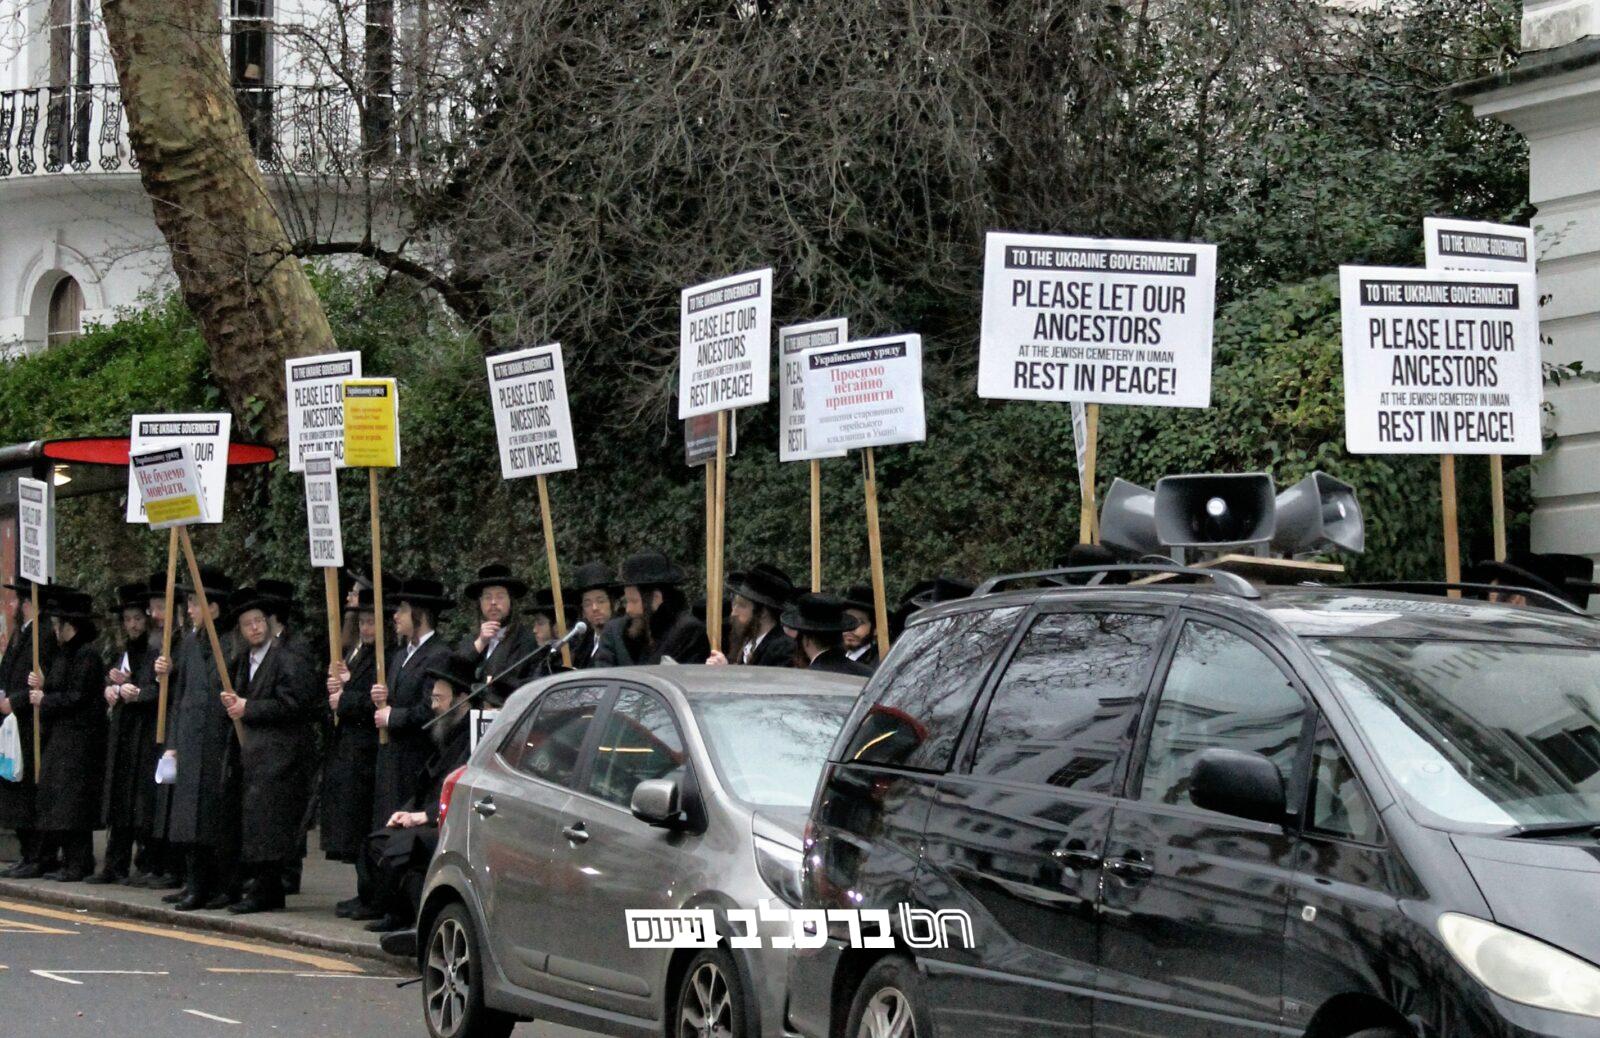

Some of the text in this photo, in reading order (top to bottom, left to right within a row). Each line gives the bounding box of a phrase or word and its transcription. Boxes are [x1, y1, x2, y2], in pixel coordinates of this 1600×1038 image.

[1441, 234, 1525, 258] TO THE UKRAINE GOVERNMENT
[1012, 249, 1190, 272] TO THE UKRAINE GOVERNMENT
[1012, 279, 1186, 314] PLEASE LET OUR
[1366, 284, 1514, 305] TO THE UKRAINE GOVERNMENT
[690, 306, 756, 344] PLEASE LET OUR
[1034, 312, 1162, 345] ANCESTORS
[1370, 318, 1514, 352] PLEASE LET OUR
[697, 335, 746, 368] ANCESTORS
[814, 346, 901, 367] Українському уряду
[1018, 345, 1174, 363] AT THE JEWISH CEMETERY IN UMAN
[831, 365, 885, 385] Просимо
[1014, 361, 1176, 395] REST IN PEACE!
[1392, 355, 1498, 387] ANCESTORS
[295, 386, 319, 407] PLEASE
[320, 385, 333, 404] LET
[499, 379, 555, 409] PLEASE LET OUR
[690, 372, 752, 408] REST IN PEACE!
[834, 378, 883, 394] негайно
[826, 390, 894, 410] припинити
[1380, 392, 1510, 406] AT THE JEWISH CEMETERY IN UMAN
[149, 424, 159, 434] THE
[160, 423, 181, 434] UKRAINE
[182, 423, 217, 434] GOVERNMENT
[303, 406, 343, 428] ANCESTORS
[510, 405, 551, 432] ANCESTORS
[1378, 411, 1514, 442] REST IN PEACE!
[195, 443, 214, 461] OUR
[510, 441, 562, 470] REST IN PEACE!
[139, 470, 152, 485] Не
